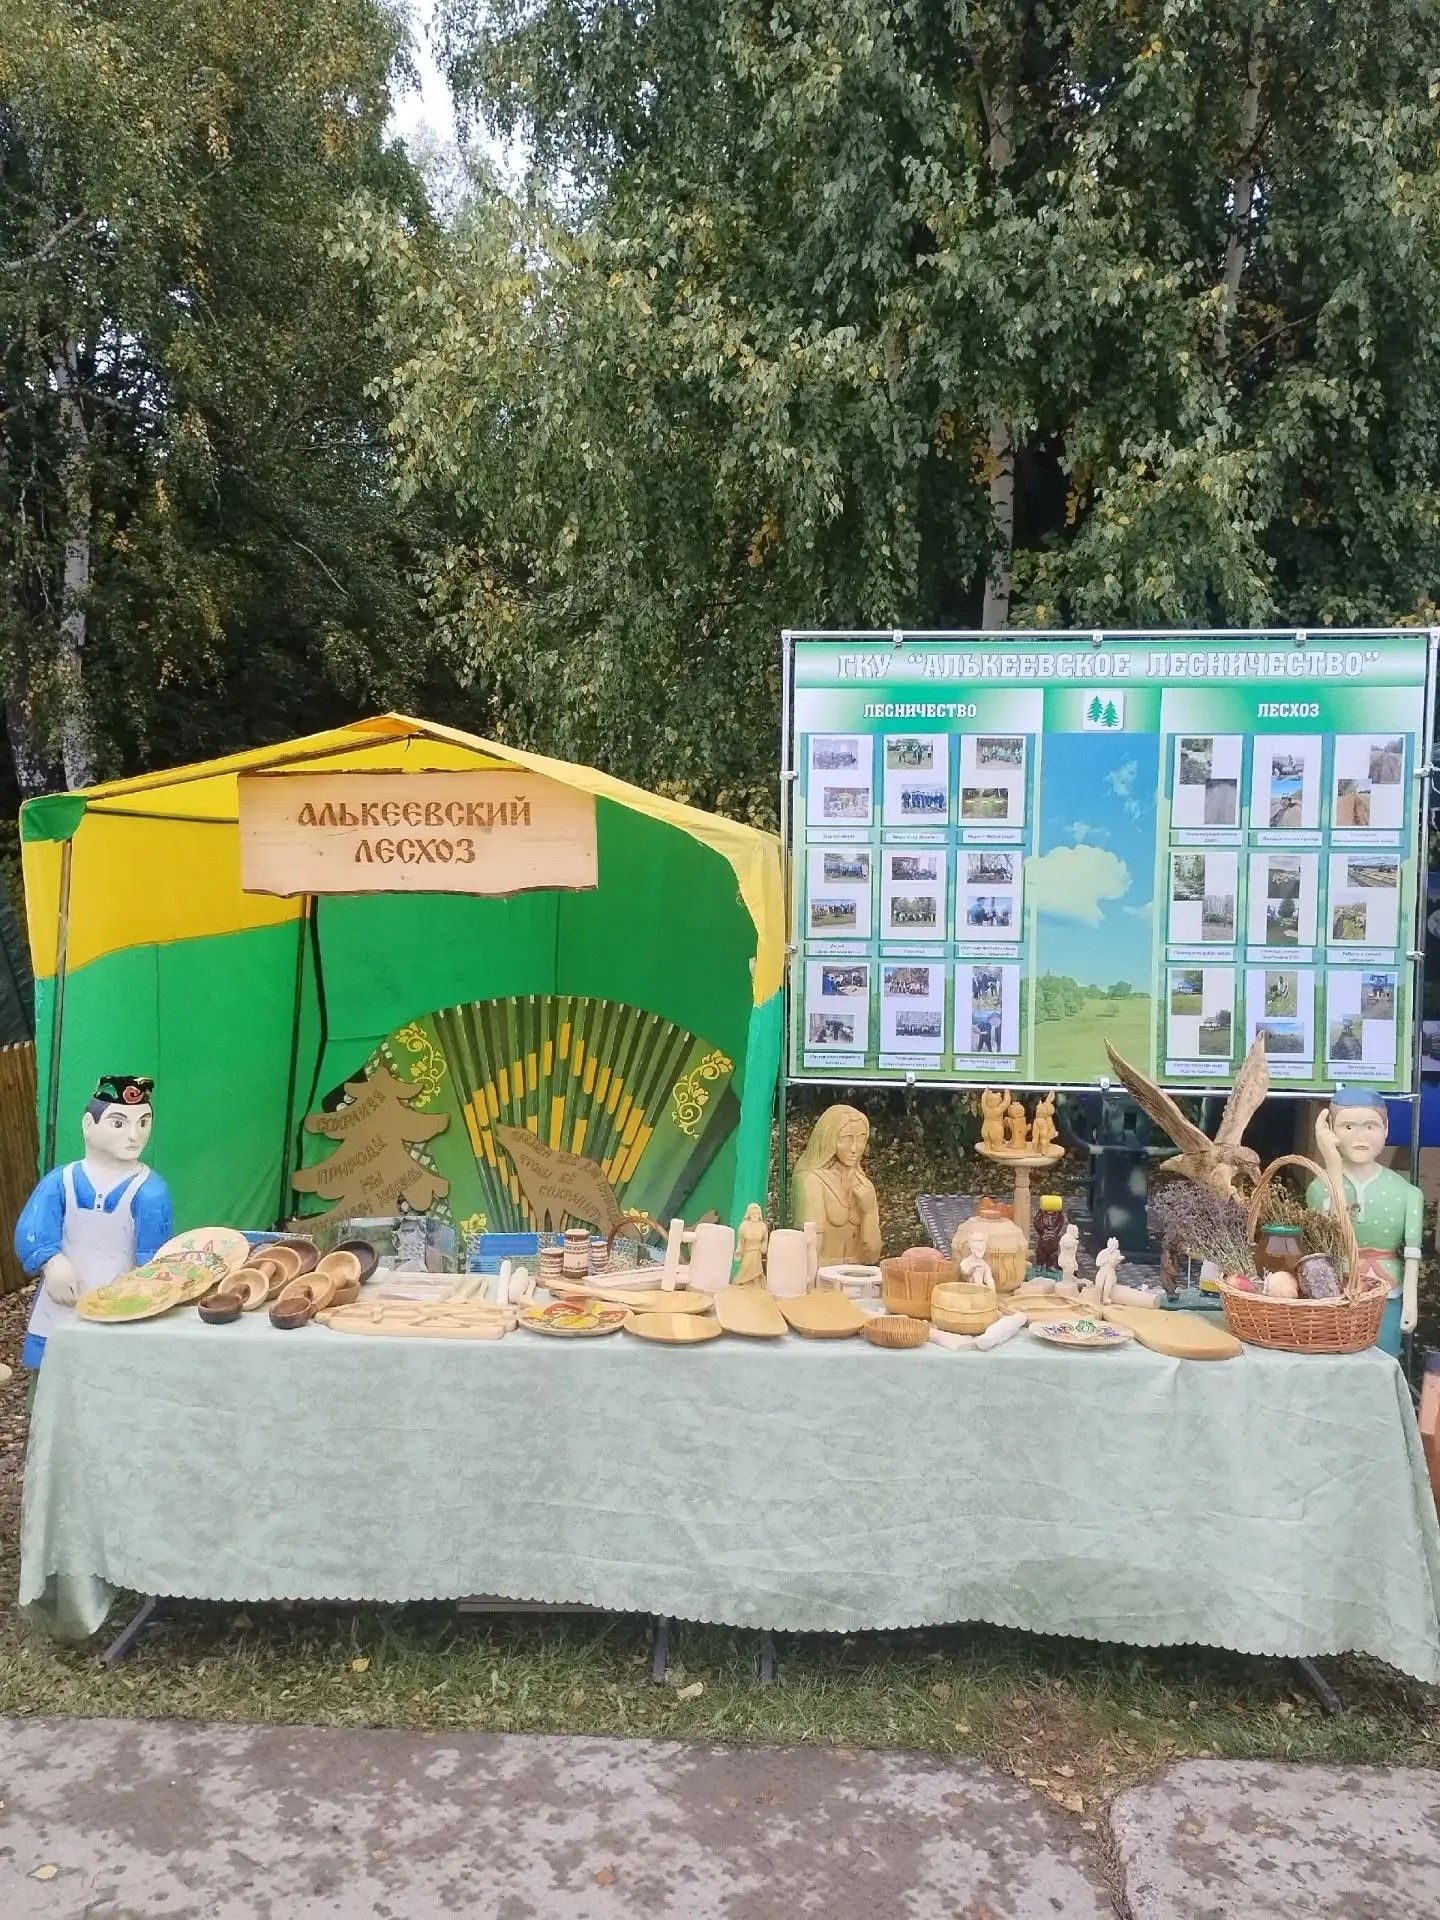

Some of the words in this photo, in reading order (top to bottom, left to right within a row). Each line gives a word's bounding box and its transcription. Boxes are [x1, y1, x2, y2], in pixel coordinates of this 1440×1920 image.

[837, 653, 893, 678] ГКУ
[863, 703, 977, 718] ЛЕСНИЧЕСТВО
[1257, 702, 1320, 718] ЛЕСХОЗ
[298, 795, 531, 827] АЛЬКЕЕВСКИЙ
[354, 838, 476, 864] ЛЕСХОЗ
